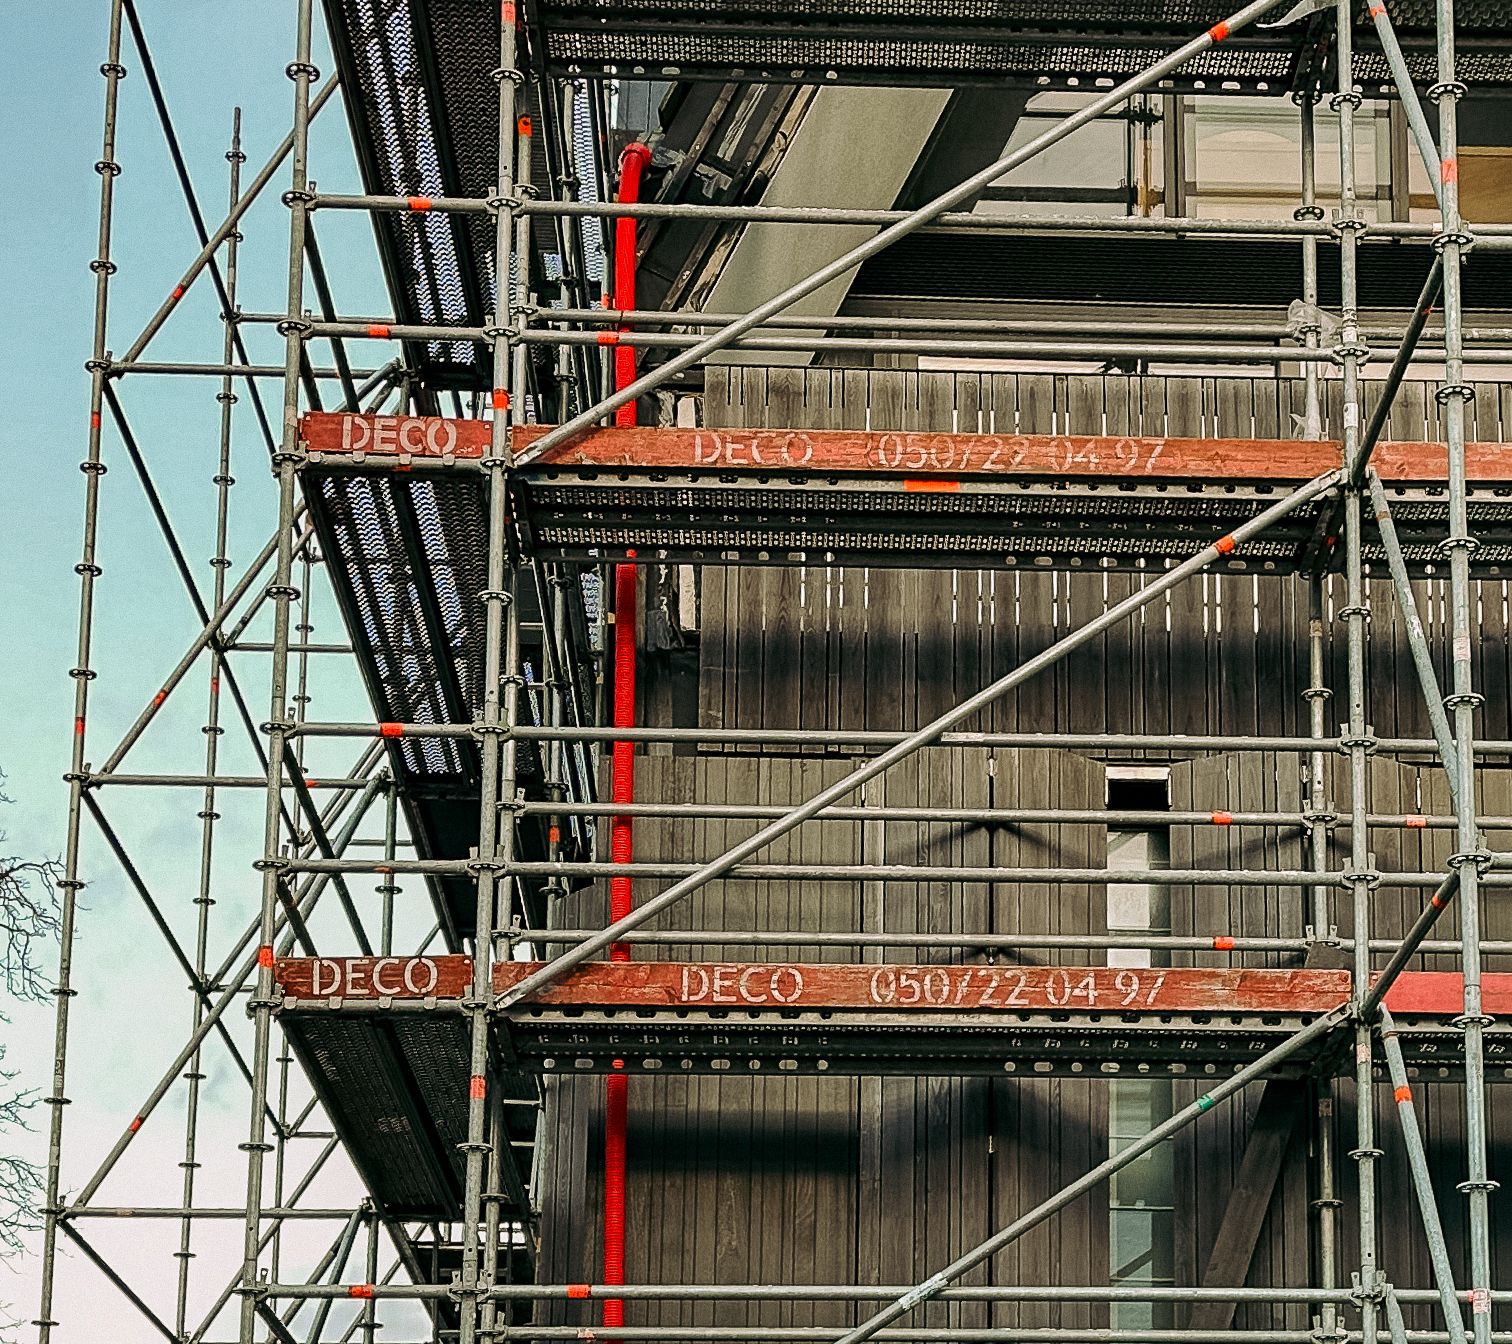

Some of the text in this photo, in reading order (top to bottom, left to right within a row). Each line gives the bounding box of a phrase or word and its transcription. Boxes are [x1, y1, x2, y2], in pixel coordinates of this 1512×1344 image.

[342, 418, 457, 453] DECO
[694, 433, 1165, 473] DECO 050/22 04 97
[312, 958, 437, 996] DECO
[681, 968, 1166, 1008] DECO 050/22 04 97
